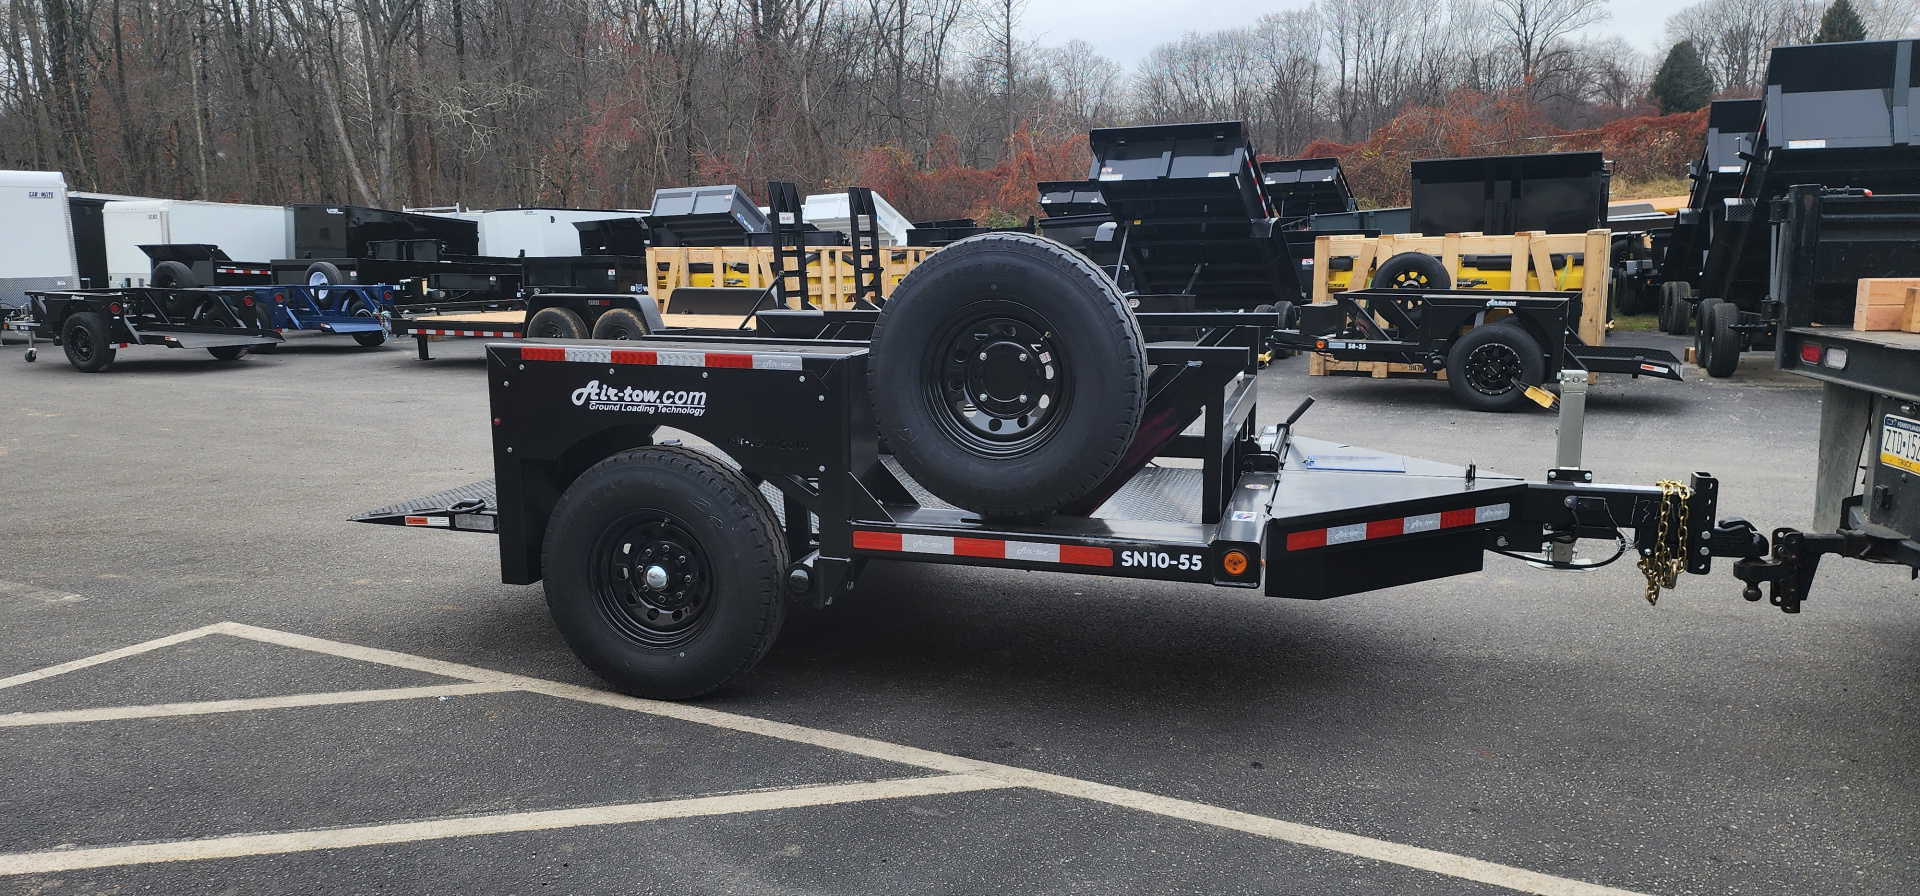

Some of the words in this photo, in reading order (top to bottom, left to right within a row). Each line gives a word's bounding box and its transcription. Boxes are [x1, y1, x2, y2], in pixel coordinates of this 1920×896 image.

[571, 380, 707, 406] Air-tow.com
[588, 402, 620, 412] Ground
[621, 403, 655, 415] Loading
[657, 405, 706, 417] Technology
[1121, 550, 1203, 571] SN10-55
